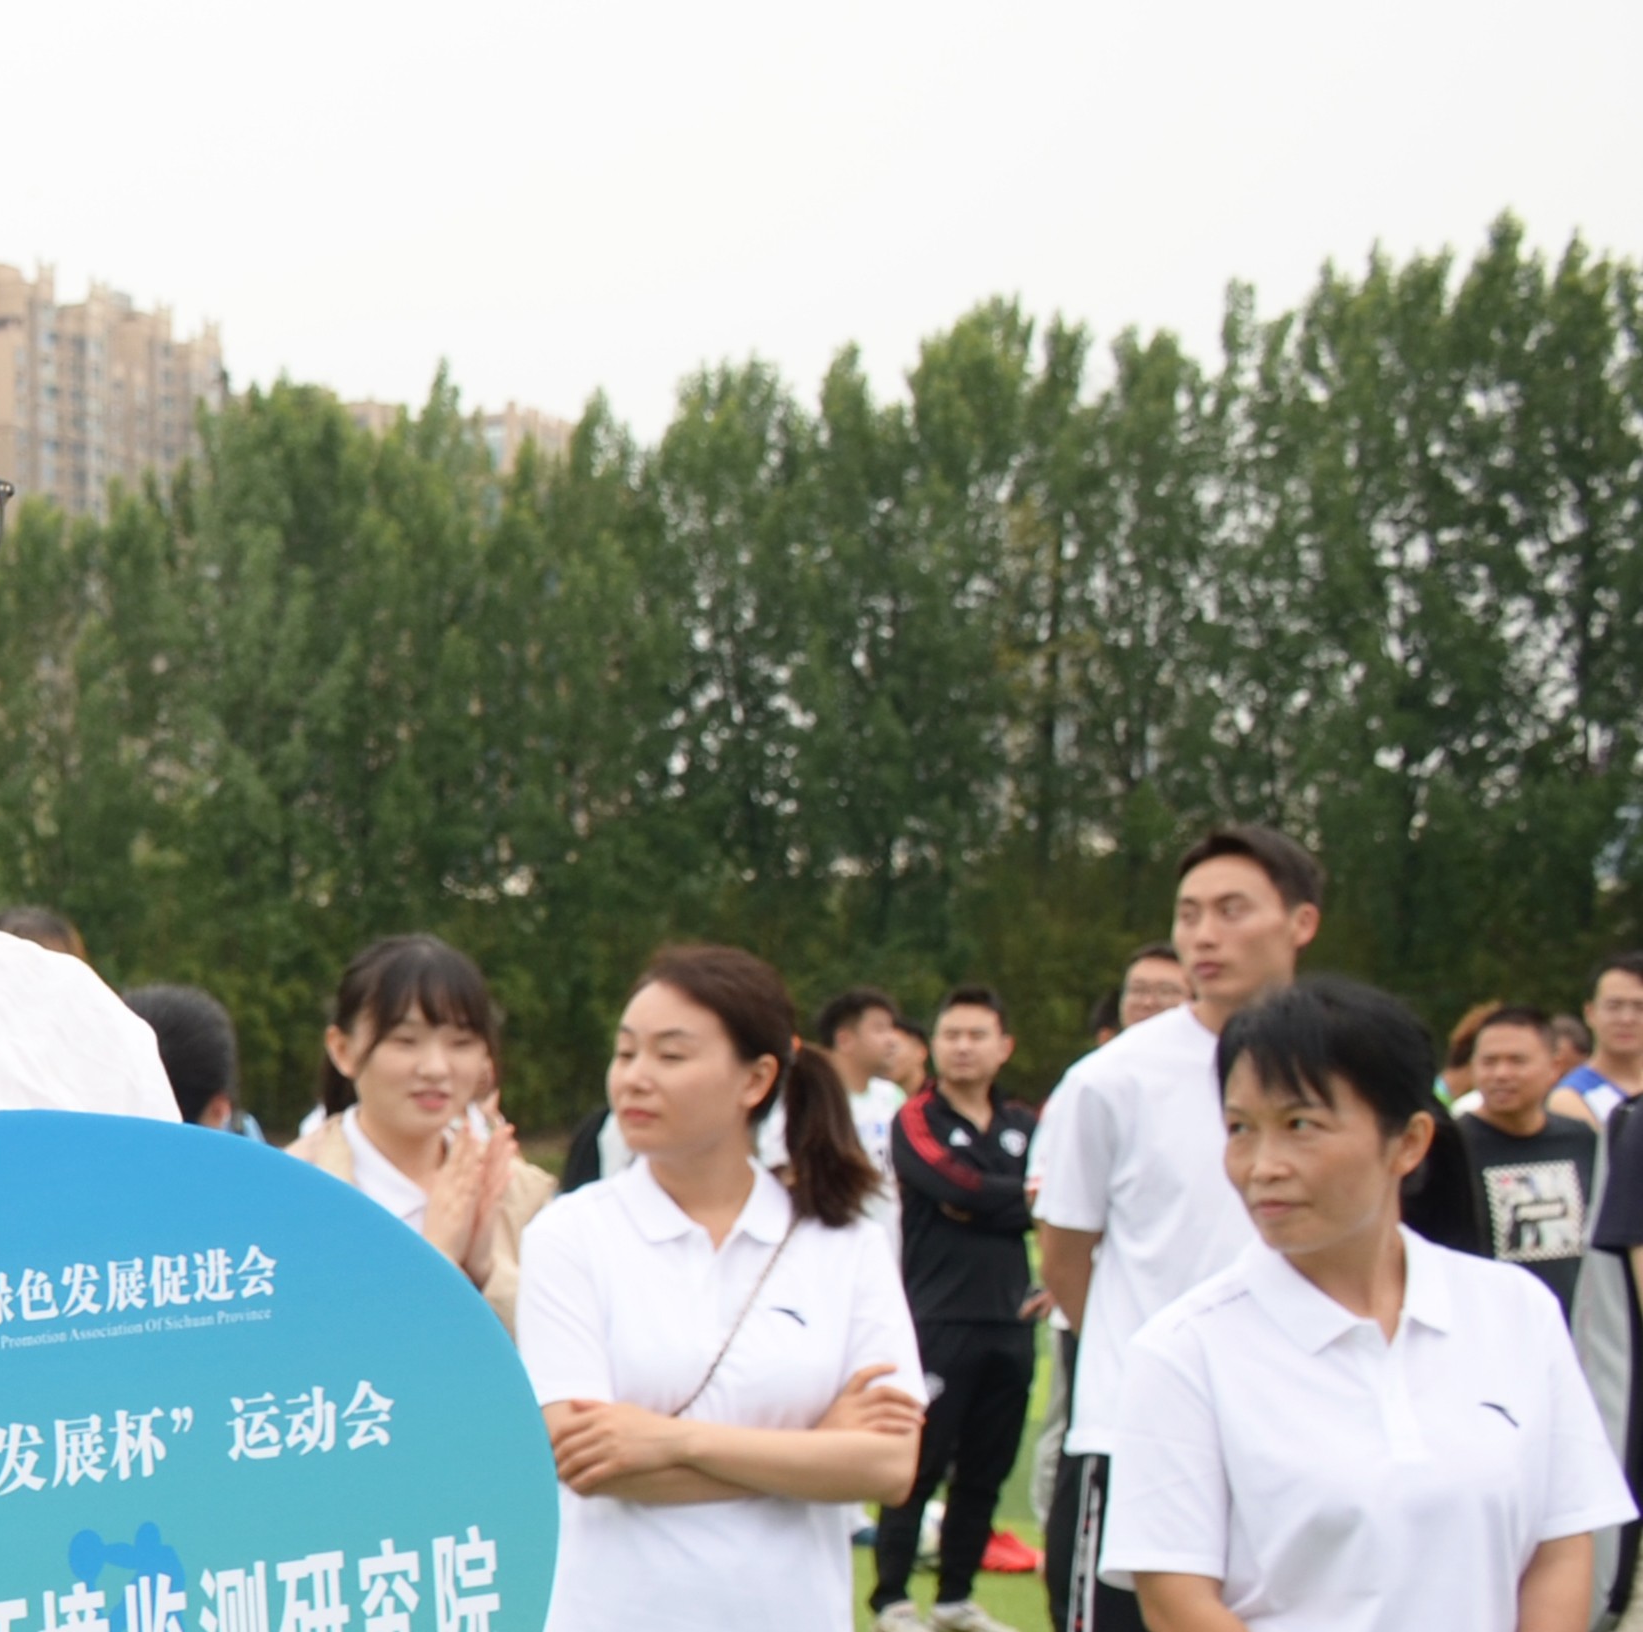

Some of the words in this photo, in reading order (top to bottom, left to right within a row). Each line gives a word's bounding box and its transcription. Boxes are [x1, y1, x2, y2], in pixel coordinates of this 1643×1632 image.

[1, 1330, 67, 1350] Promotion
[70, 1322, 143, 1342] Association
[145, 1317, 165, 1332] Of
[165, 1312, 215, 1331] Sichuan
[218, 1307, 272, 1326] Province
